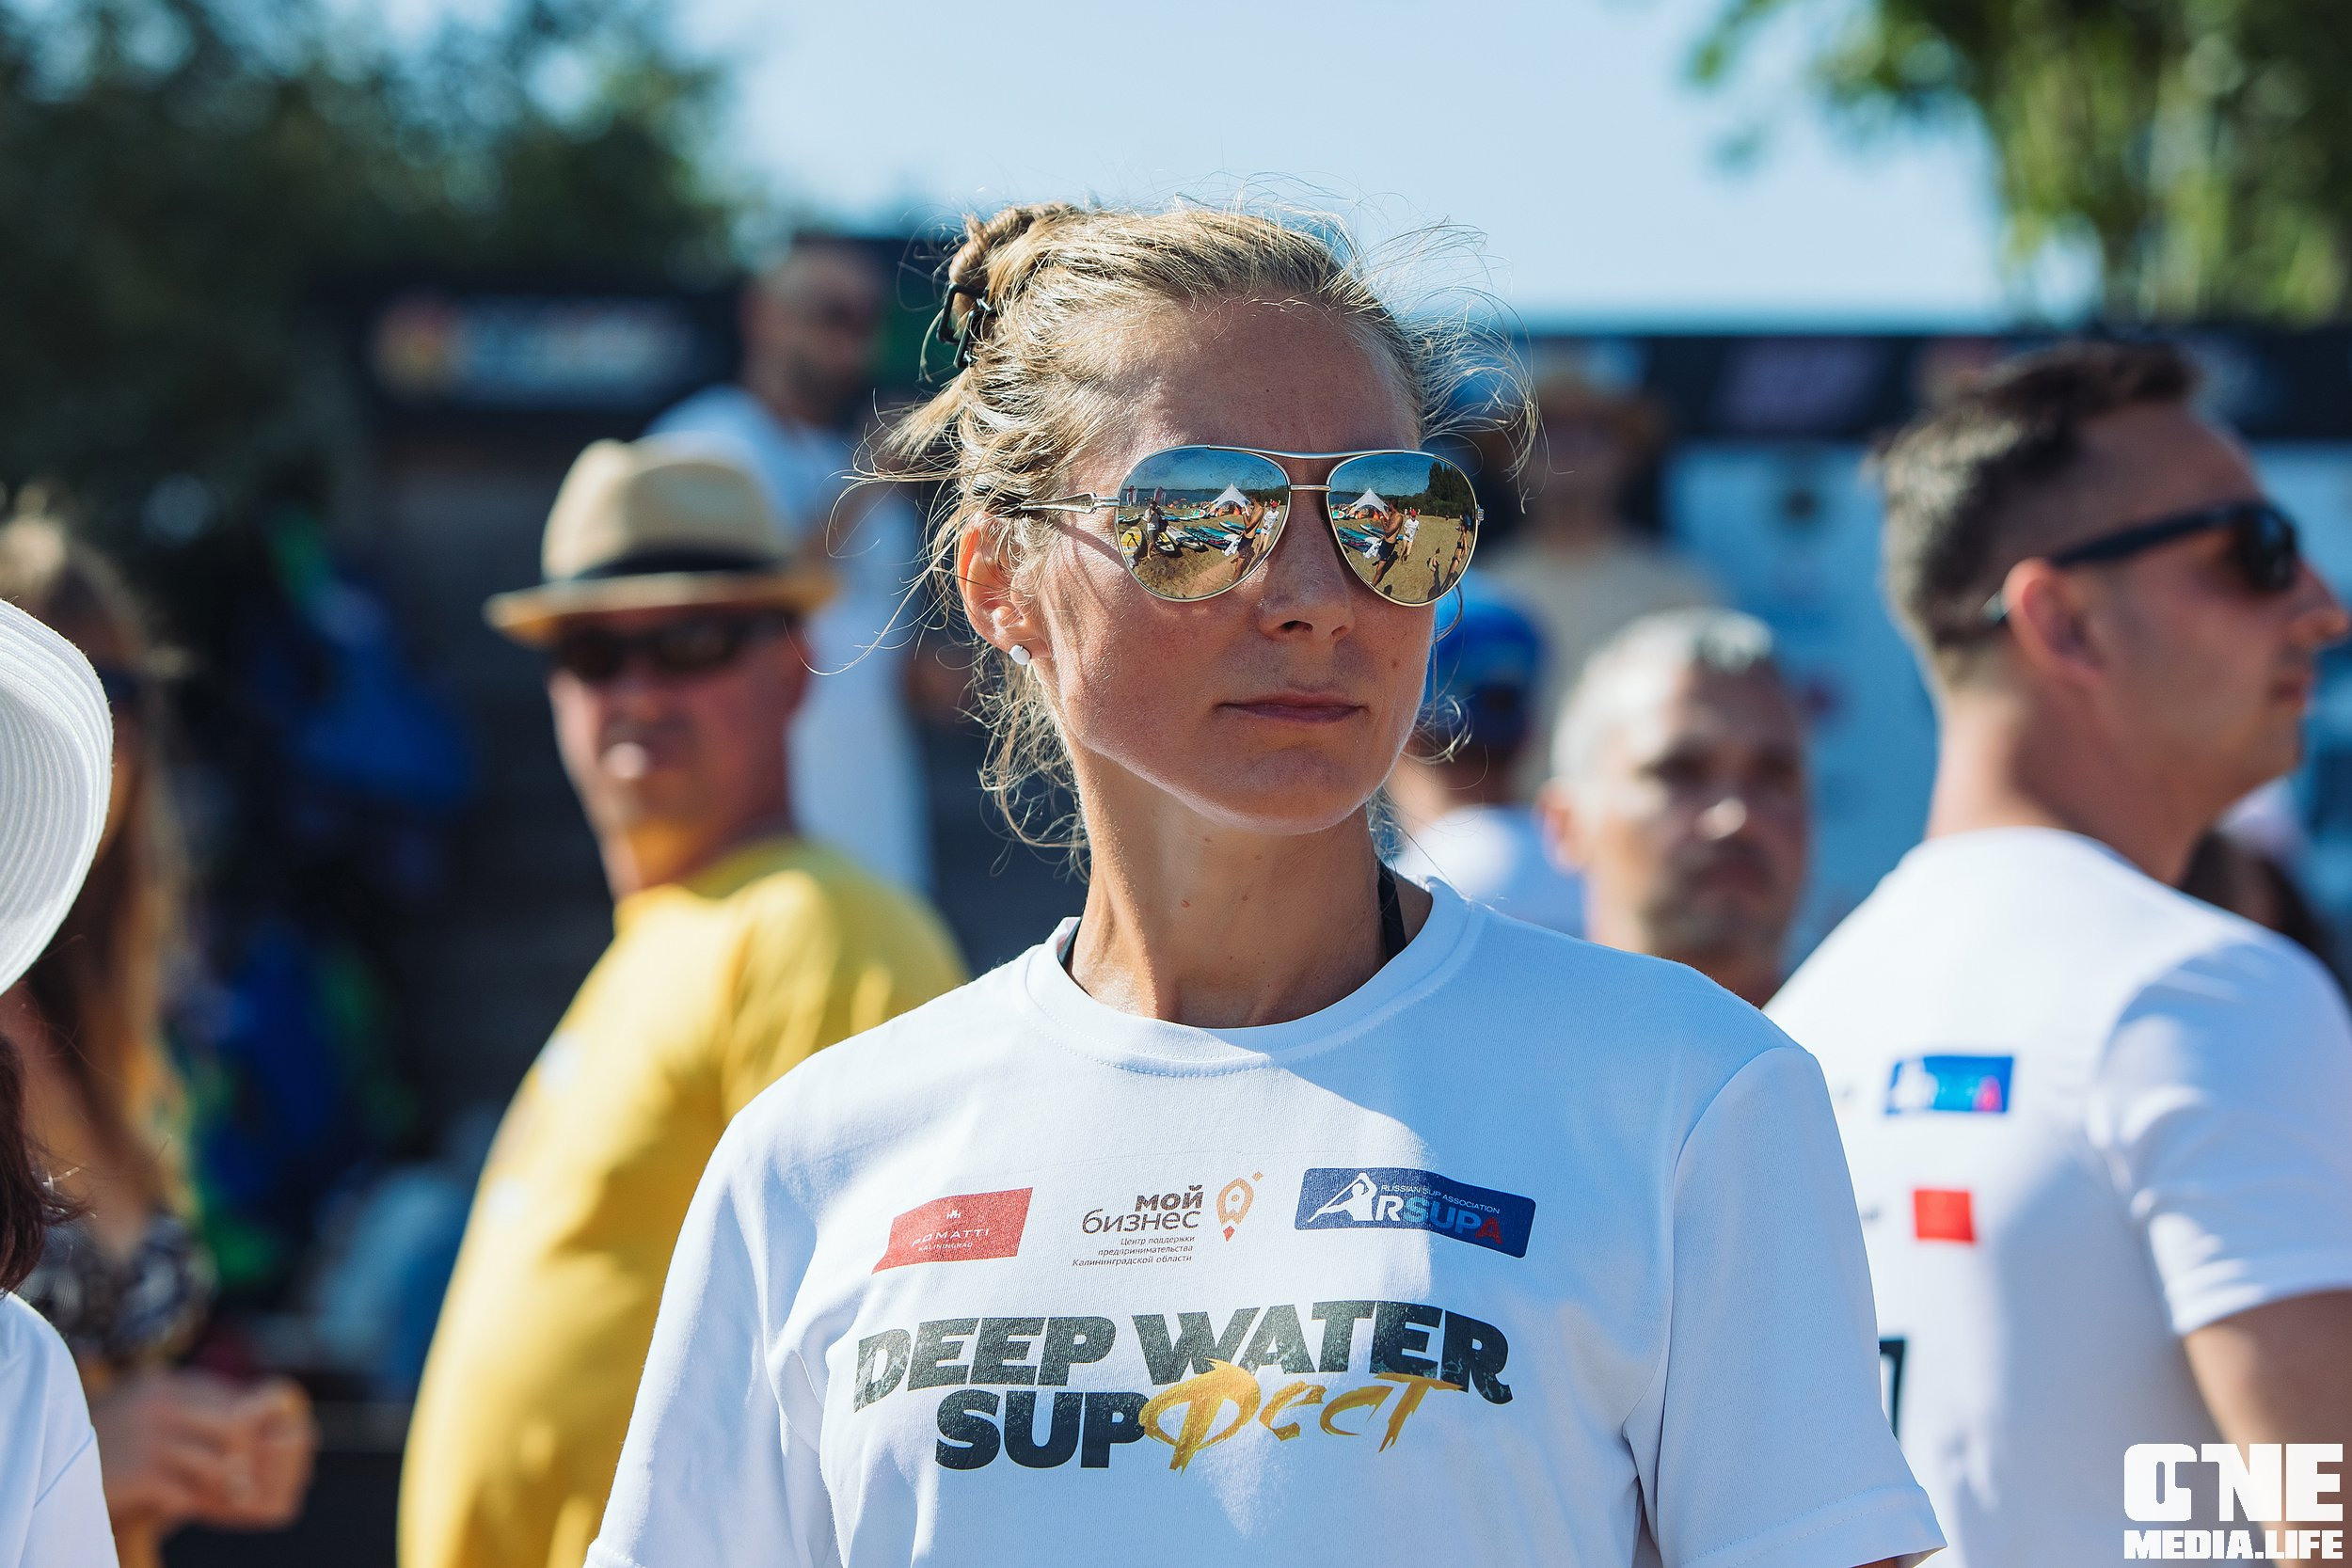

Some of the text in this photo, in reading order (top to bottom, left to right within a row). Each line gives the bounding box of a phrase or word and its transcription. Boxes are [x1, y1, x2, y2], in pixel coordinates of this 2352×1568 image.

[1380, 1184, 1500, 1214] RUSSIAN SUP ASSOCIATION
[1082, 1209, 1200, 1234] бизнес
[1098, 1245, 1194, 1257] предпринимательства
[1120, 1236, 1196, 1246] Центр поддержки
[1072, 1255, 1193, 1267] Калининградской области
[854, 1300, 1514, 1414] DEEP WATER
[935, 1390, 1147, 1470] SUP
